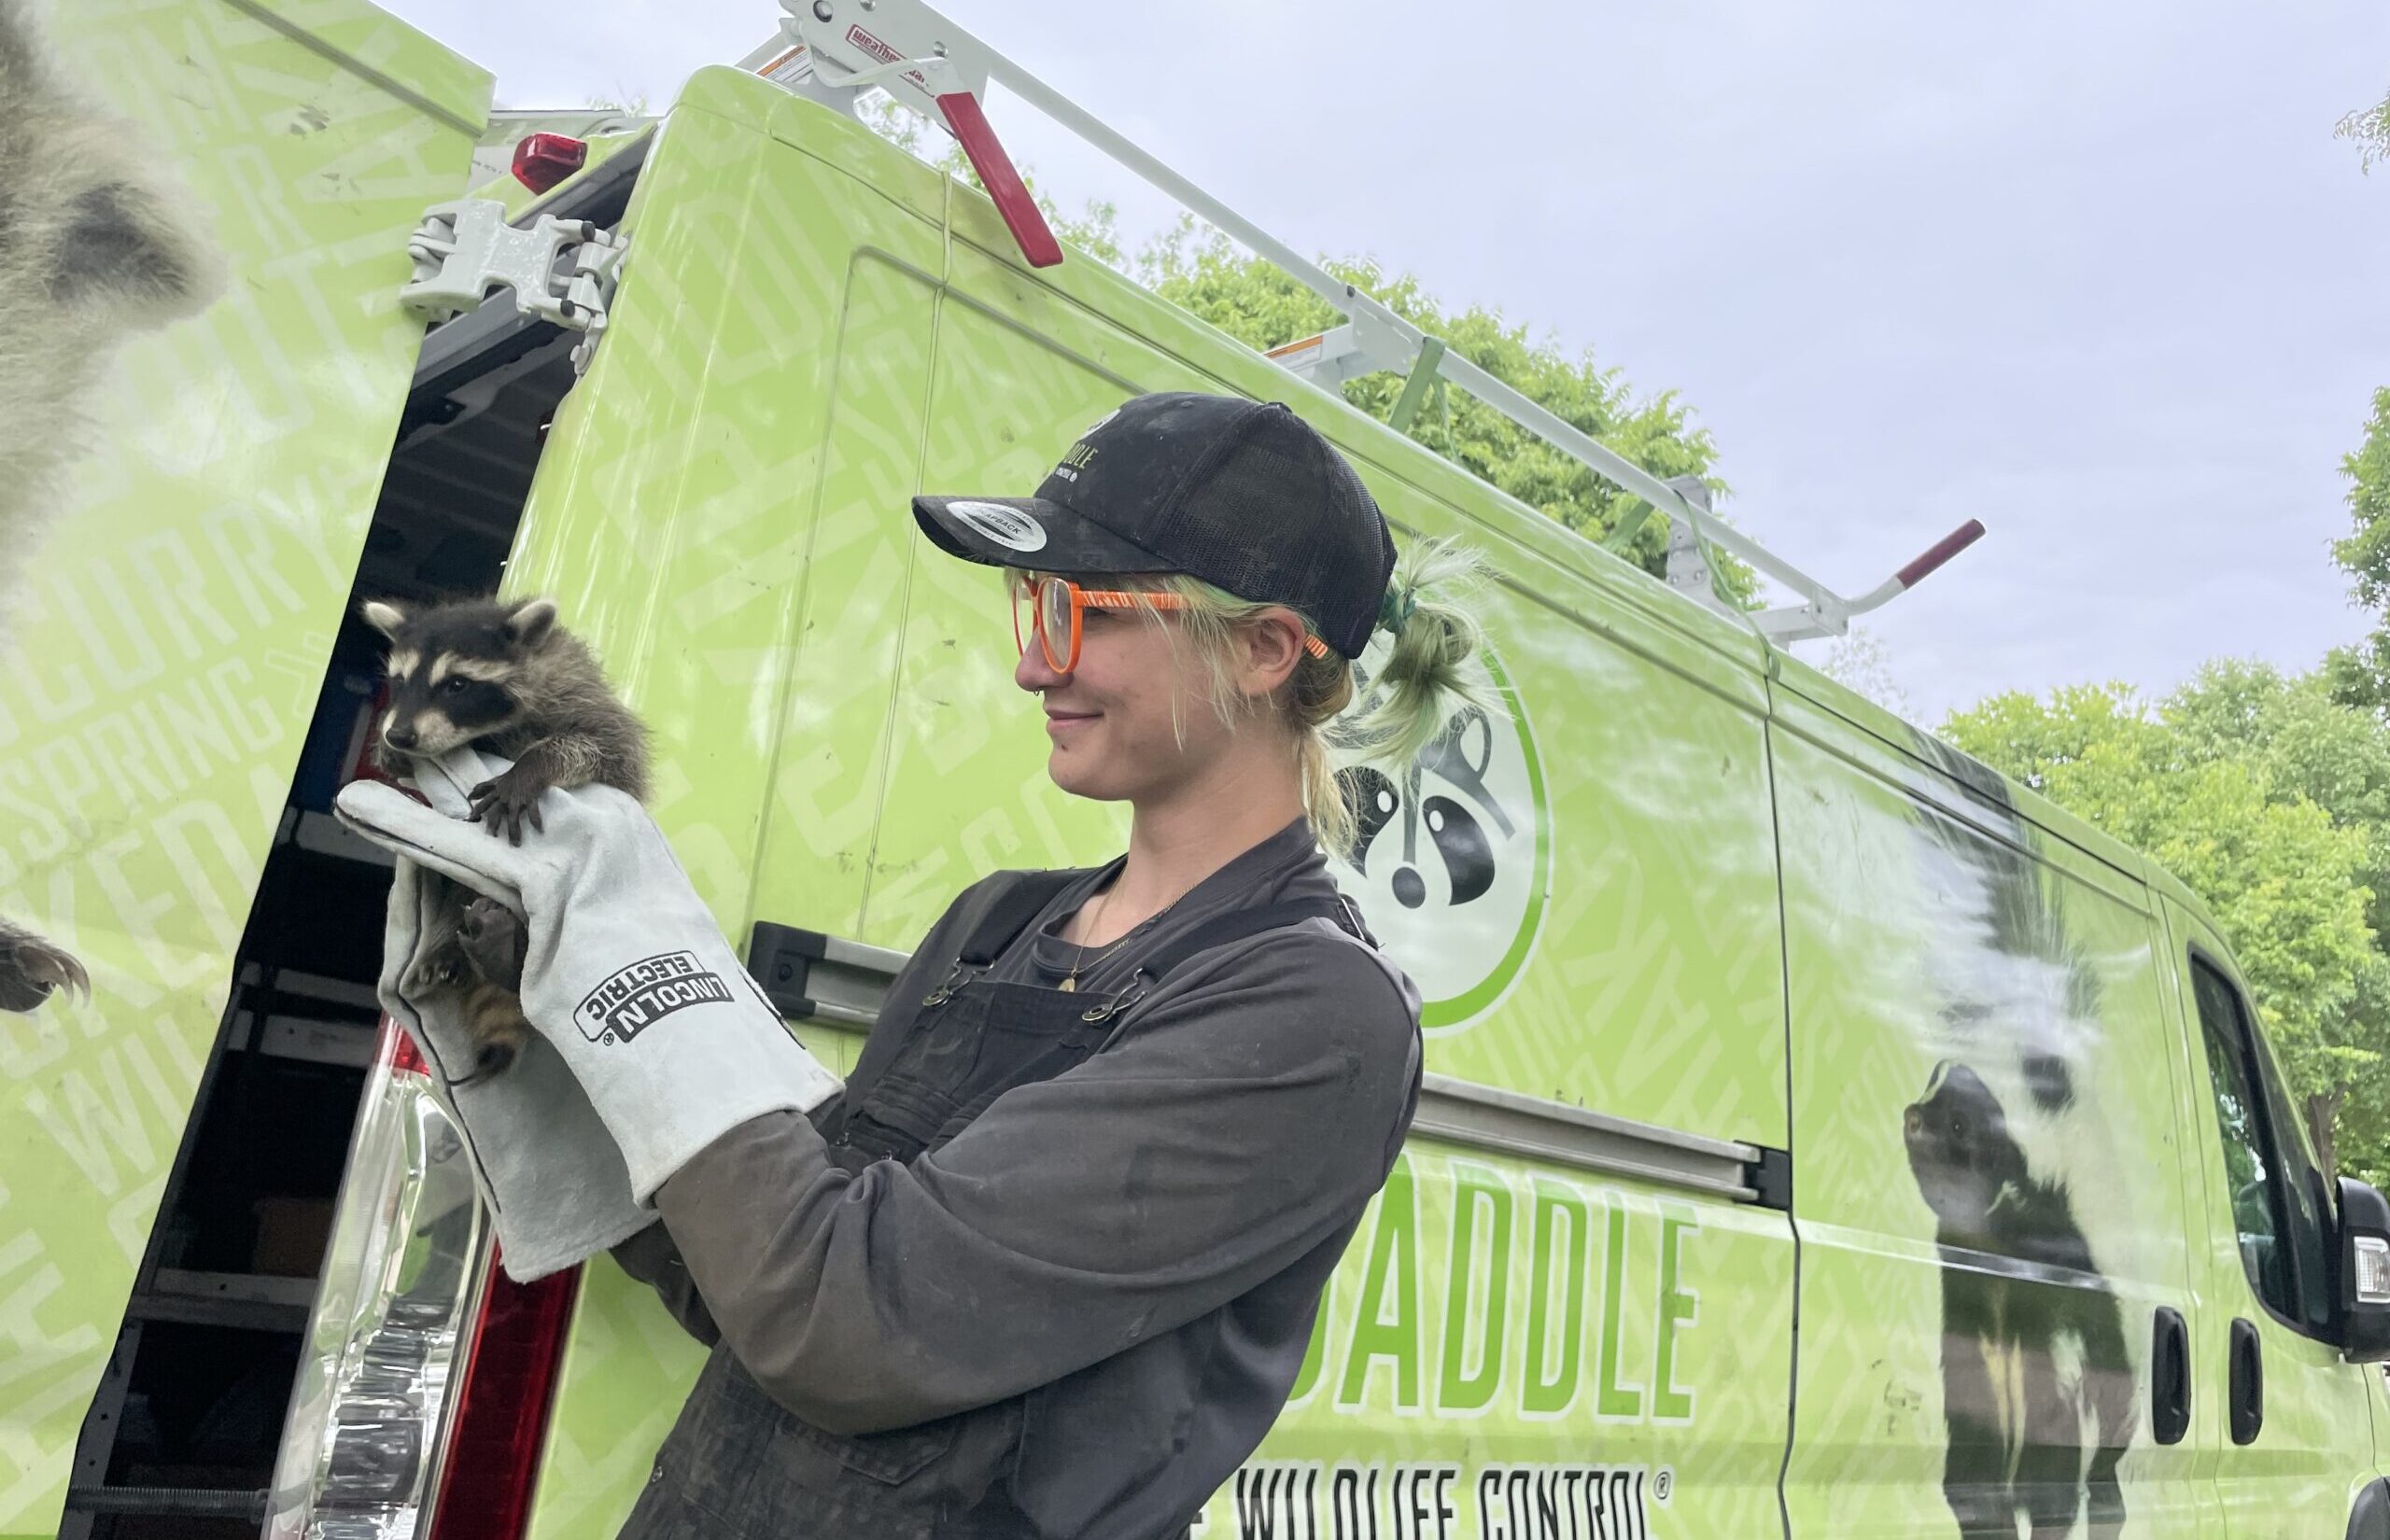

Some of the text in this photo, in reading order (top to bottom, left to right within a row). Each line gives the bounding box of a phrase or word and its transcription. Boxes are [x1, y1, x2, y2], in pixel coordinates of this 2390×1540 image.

[585, 956, 695, 1021] ELECTRIC
[616, 977, 730, 1034] LINCOLN
[1286, 1152, 1699, 1420] ADDLE
